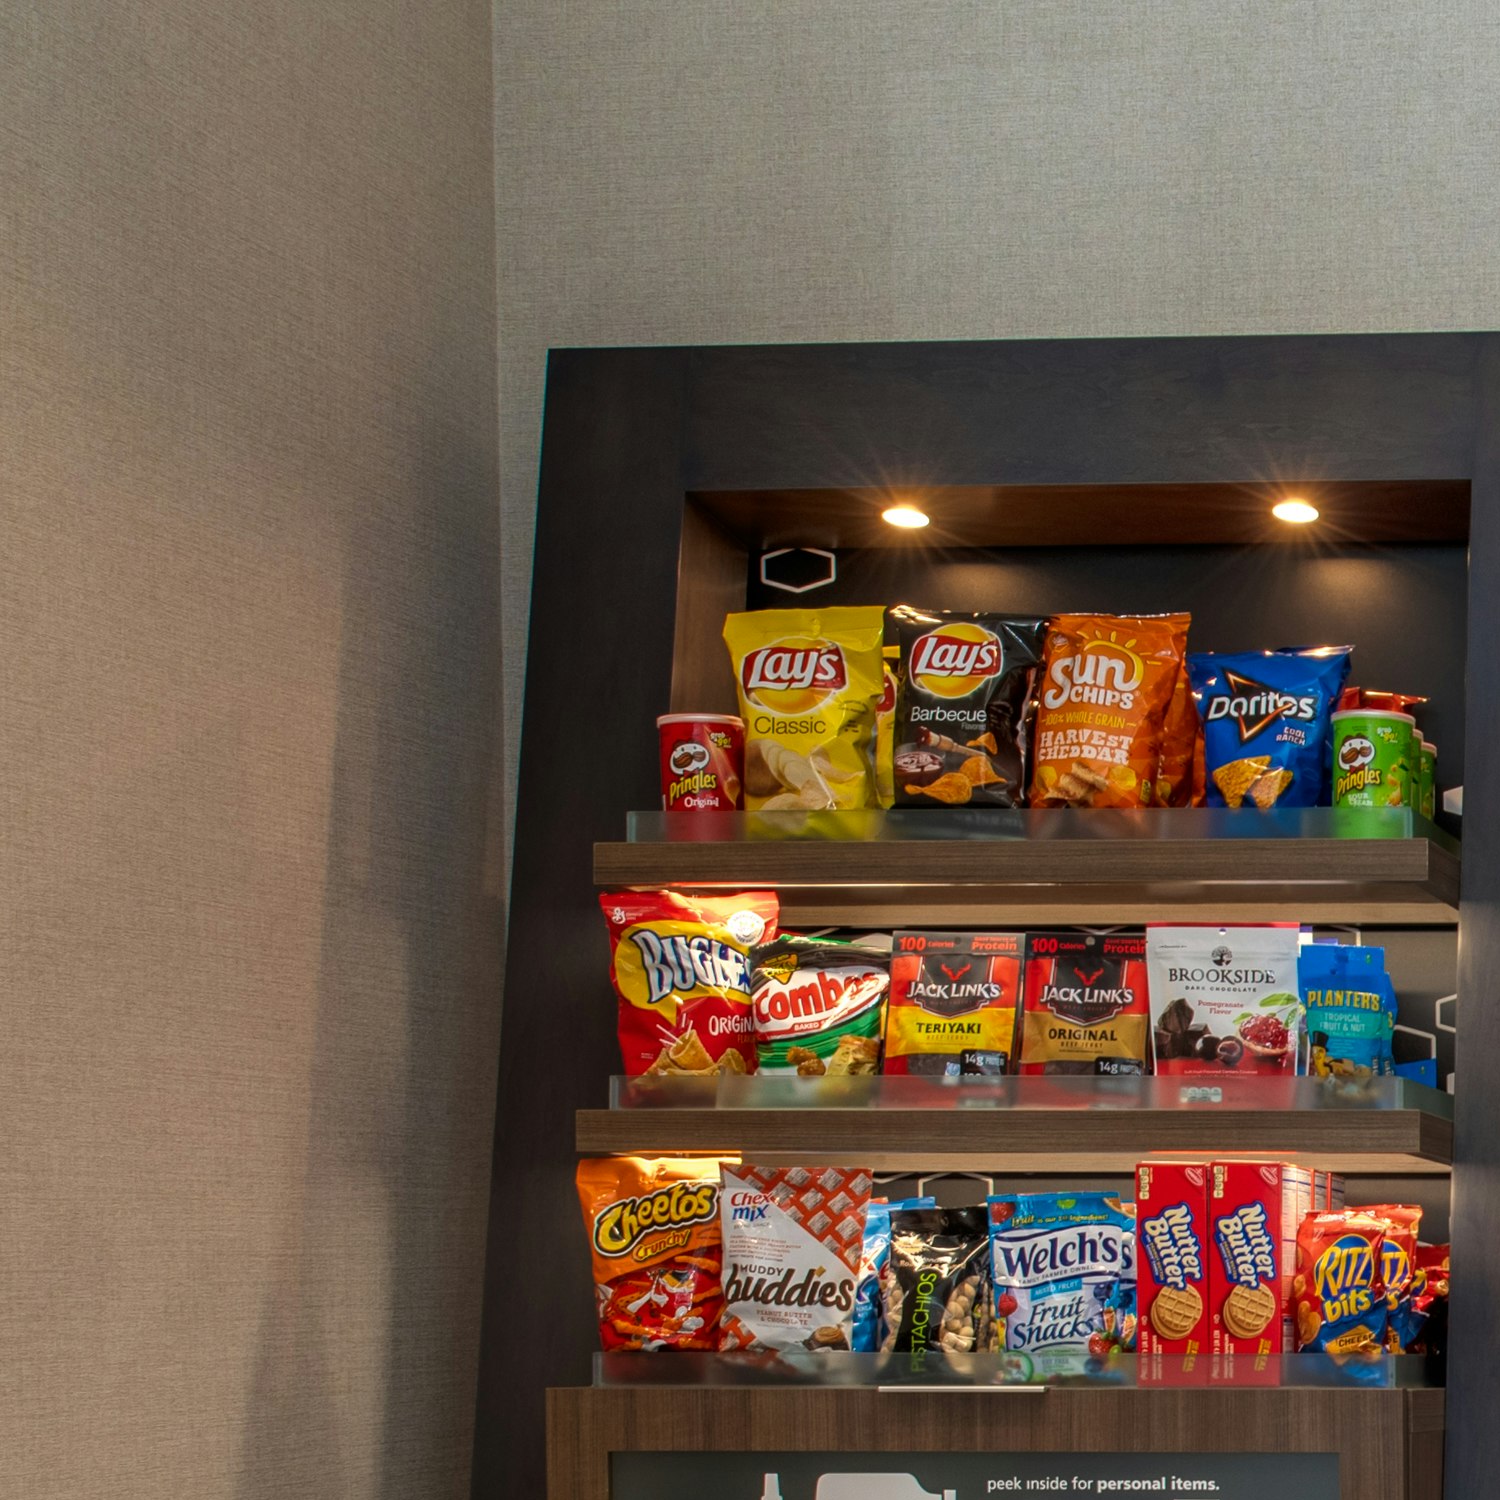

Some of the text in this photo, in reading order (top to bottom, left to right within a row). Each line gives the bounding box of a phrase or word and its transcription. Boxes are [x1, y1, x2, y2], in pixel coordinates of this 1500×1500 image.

[914, 637, 999, 677] Lay's
[747, 645, 840, 689] Lay's
[1045, 654, 1144, 709] Sun
[1070, 686, 1134, 709] CHIPS
[1208, 691, 1315, 720] Doritos
[911, 706, 987, 722] Barbecue
[1066, 712, 1091, 724] WHOLE
[1095, 713, 1125, 728] GRAIN
[754, 716, 826, 735] Classic
[1284, 726, 1305, 738] COOL
[1040, 728, 1133, 752] HARVEST
[1039, 745, 1129, 765] CHEDDAR
[670, 770, 717, 805] Pringles
[1337, 769, 1381, 805] Pringles
[689, 796, 719, 808] Original
[899, 937, 926, 951] 100
[971, 941, 1017, 951] Protein
[1032, 938, 1058, 953] 100
[1168, 967, 1276, 986] BROOKSIDE
[907, 982, 1000, 998] JACK LINK'S
[1040, 985, 1133, 1004] JACK LINK'S
[1198, 1000, 1244, 1009] Pomegranate
[1307, 990, 1380, 1011] PLANTERS
[795, 1022, 820, 1031] BAKED
[1320, 1021, 1340, 1030] FRUIT
[1350, 1024, 1365, 1032] NUT
[1324, 1013, 1360, 1022] TROPICAL
[916, 1023, 981, 1034] TERIYAKI
[1048, 1028, 1117, 1042] ORIGINAL
[731, 1192, 774, 1206] Chex
[598, 1183, 714, 1252] Cheetos
[1011, 1214, 1034, 1227] Fruit
[633, 1229, 690, 1261] Crunchy
[1163, 1203, 1201, 1280] Nutter
[1237, 1203, 1274, 1280] Nutter
[999, 1231, 1119, 1278] Welch's
[1143, 1216, 1185, 1289] Butter
[1218, 1215, 1257, 1289] Butter
[741, 1265, 784, 1277] MUDDY
[1041, 1270, 1068, 1280] FARMER
[1315, 1246, 1372, 1297] RITZ
[726, 1263, 854, 1311] buddies
[1058, 1281, 1078, 1291] FRUIT
[757, 1310, 782, 1318] PEANUT
[1029, 1296, 1085, 1326] Fruit
[1324, 1289, 1371, 1322] bits
[1013, 1316, 1094, 1349] Snacks
[1338, 1334, 1373, 1347] CHEESE
[987, 1475, 1220, 1493] peek inside for personal items.
